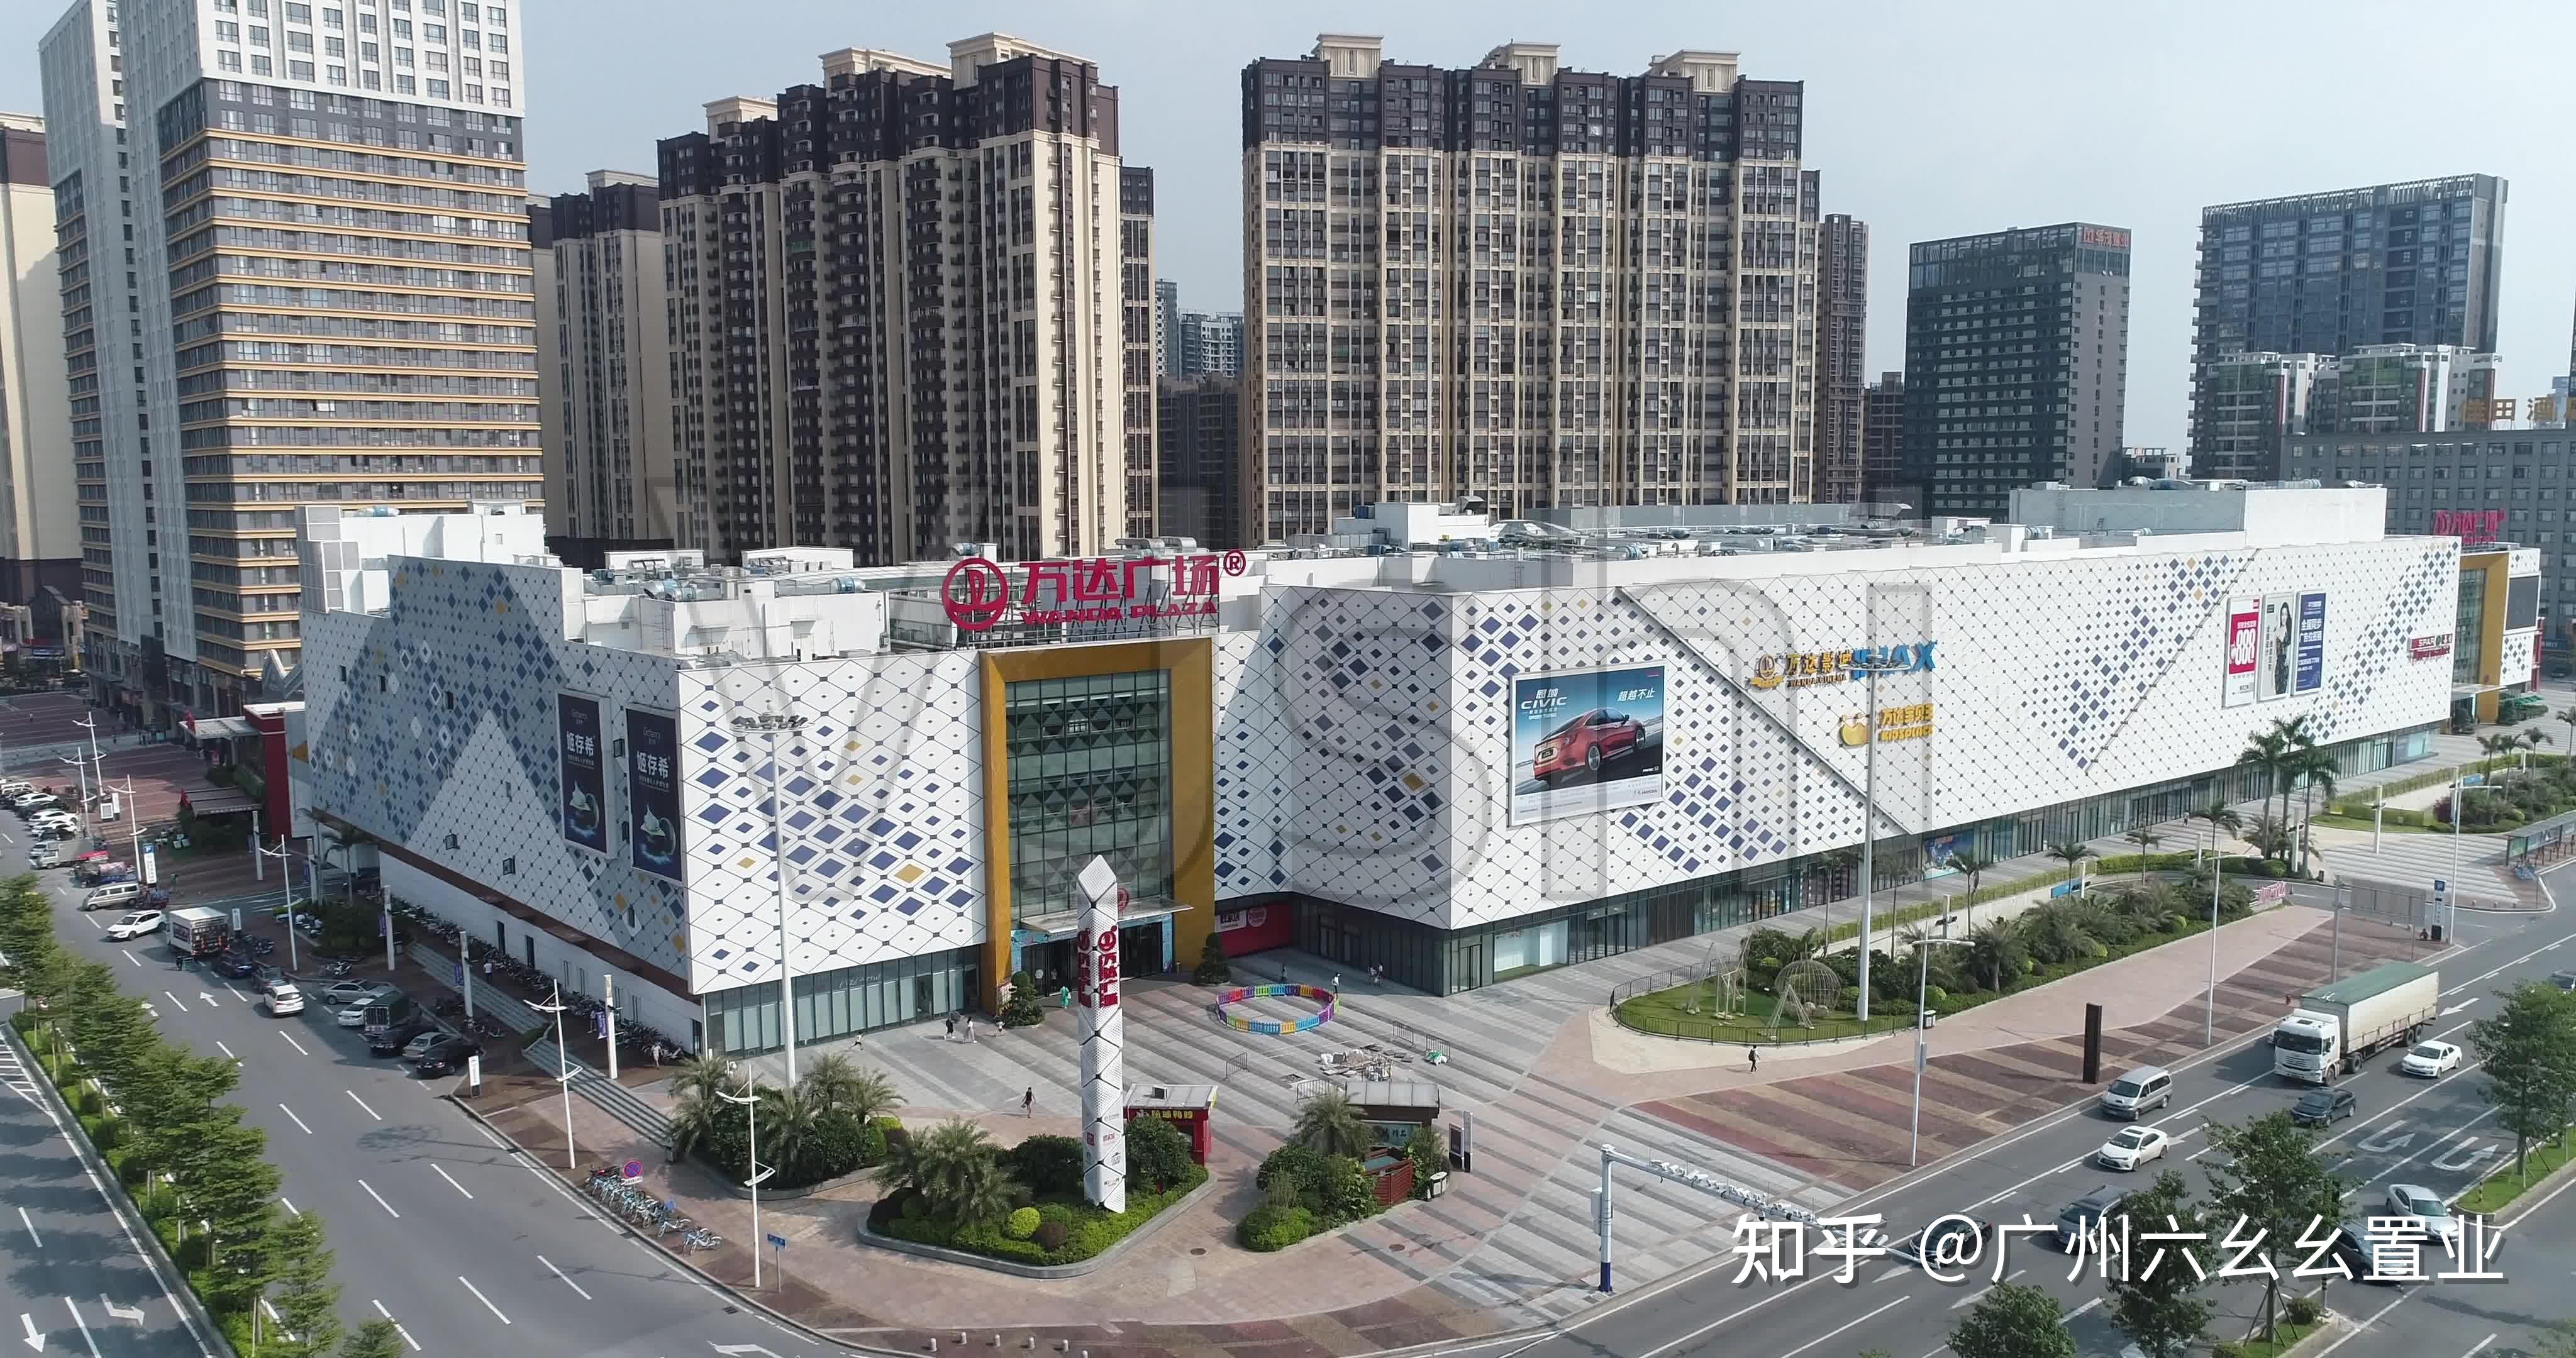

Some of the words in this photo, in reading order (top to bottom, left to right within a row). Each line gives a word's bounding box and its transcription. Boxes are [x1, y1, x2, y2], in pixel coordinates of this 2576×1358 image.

[1019, 555, 1219, 604] 万达广场
[1021, 607, 1123, 625] WANDA
[1131, 601, 1218, 619] PLAZA
[1521, 697, 1567, 710] CIVIC
[1618, 687, 1655, 702] 超越不止
[637, 751, 669, 779] 姬存希
